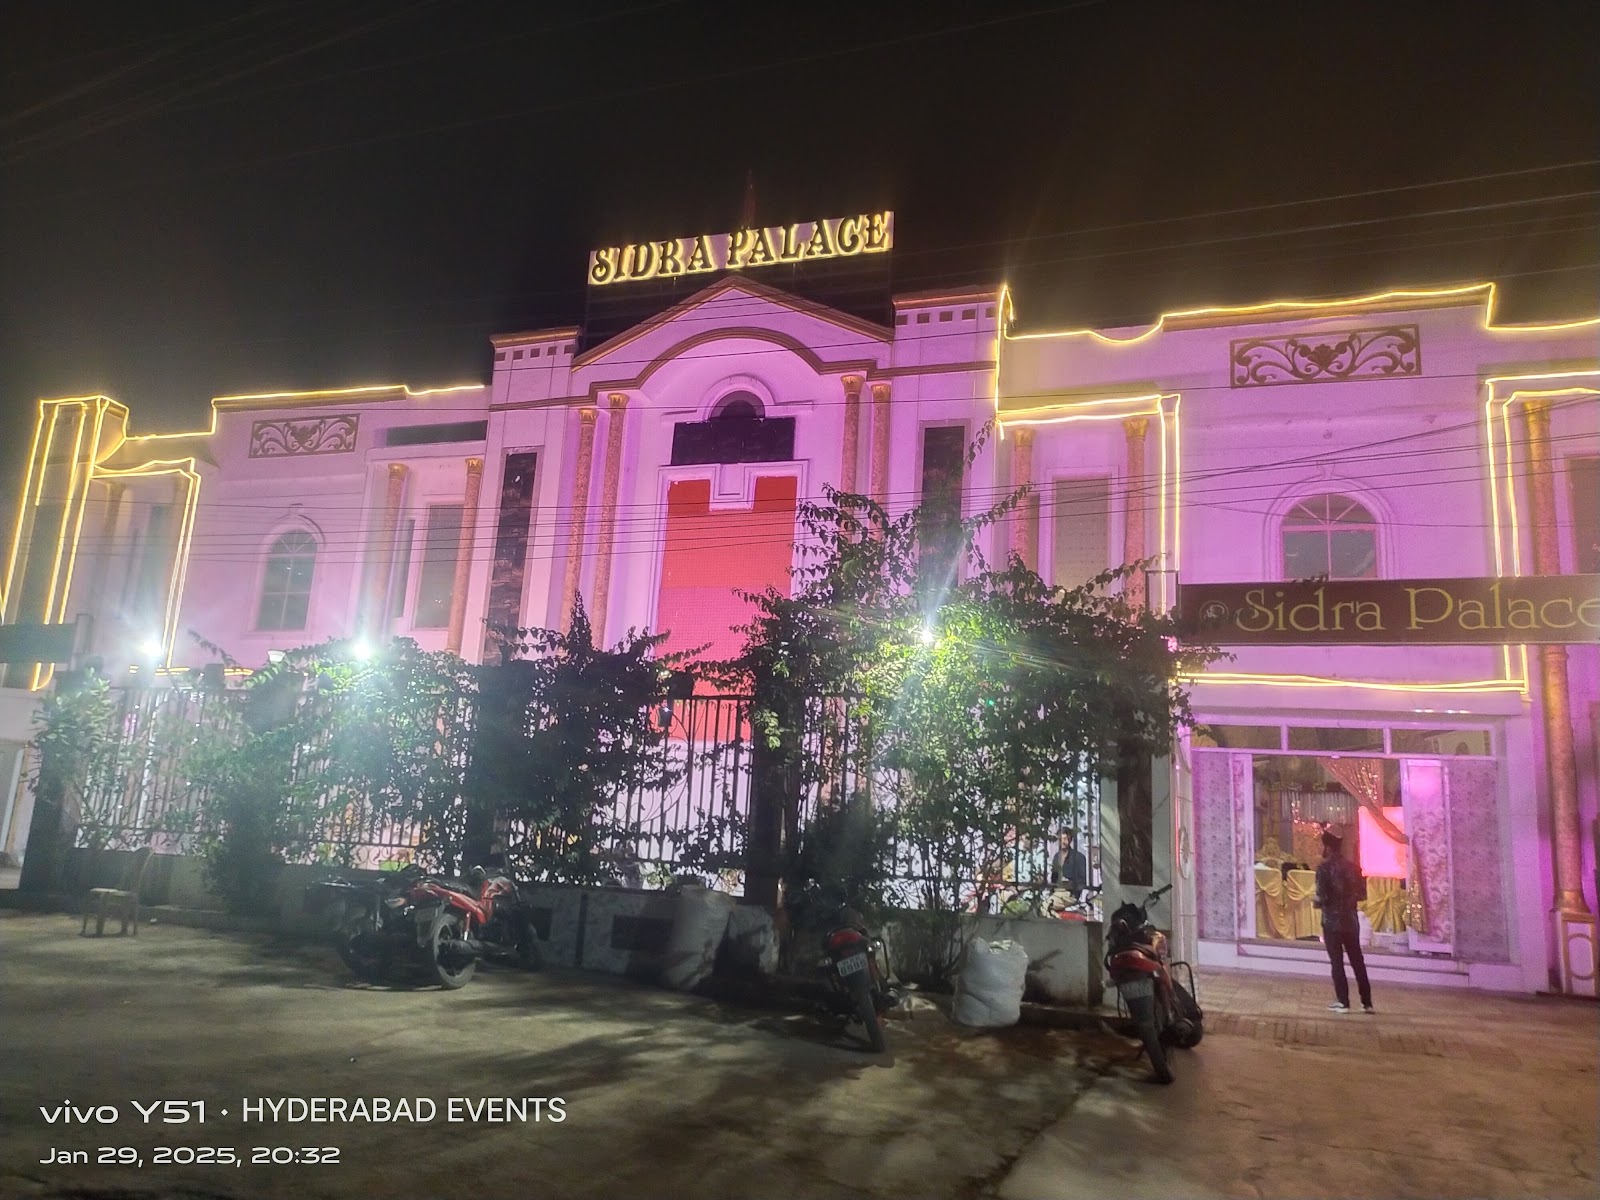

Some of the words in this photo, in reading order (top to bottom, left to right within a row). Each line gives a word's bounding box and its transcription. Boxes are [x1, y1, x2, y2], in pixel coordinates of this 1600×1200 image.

[591, 235, 714, 283] SIDRA
[725, 212, 893, 267] PALACE
[1235, 586, 1387, 632] Sidra
[1404, 582, 1600, 630] Palace
